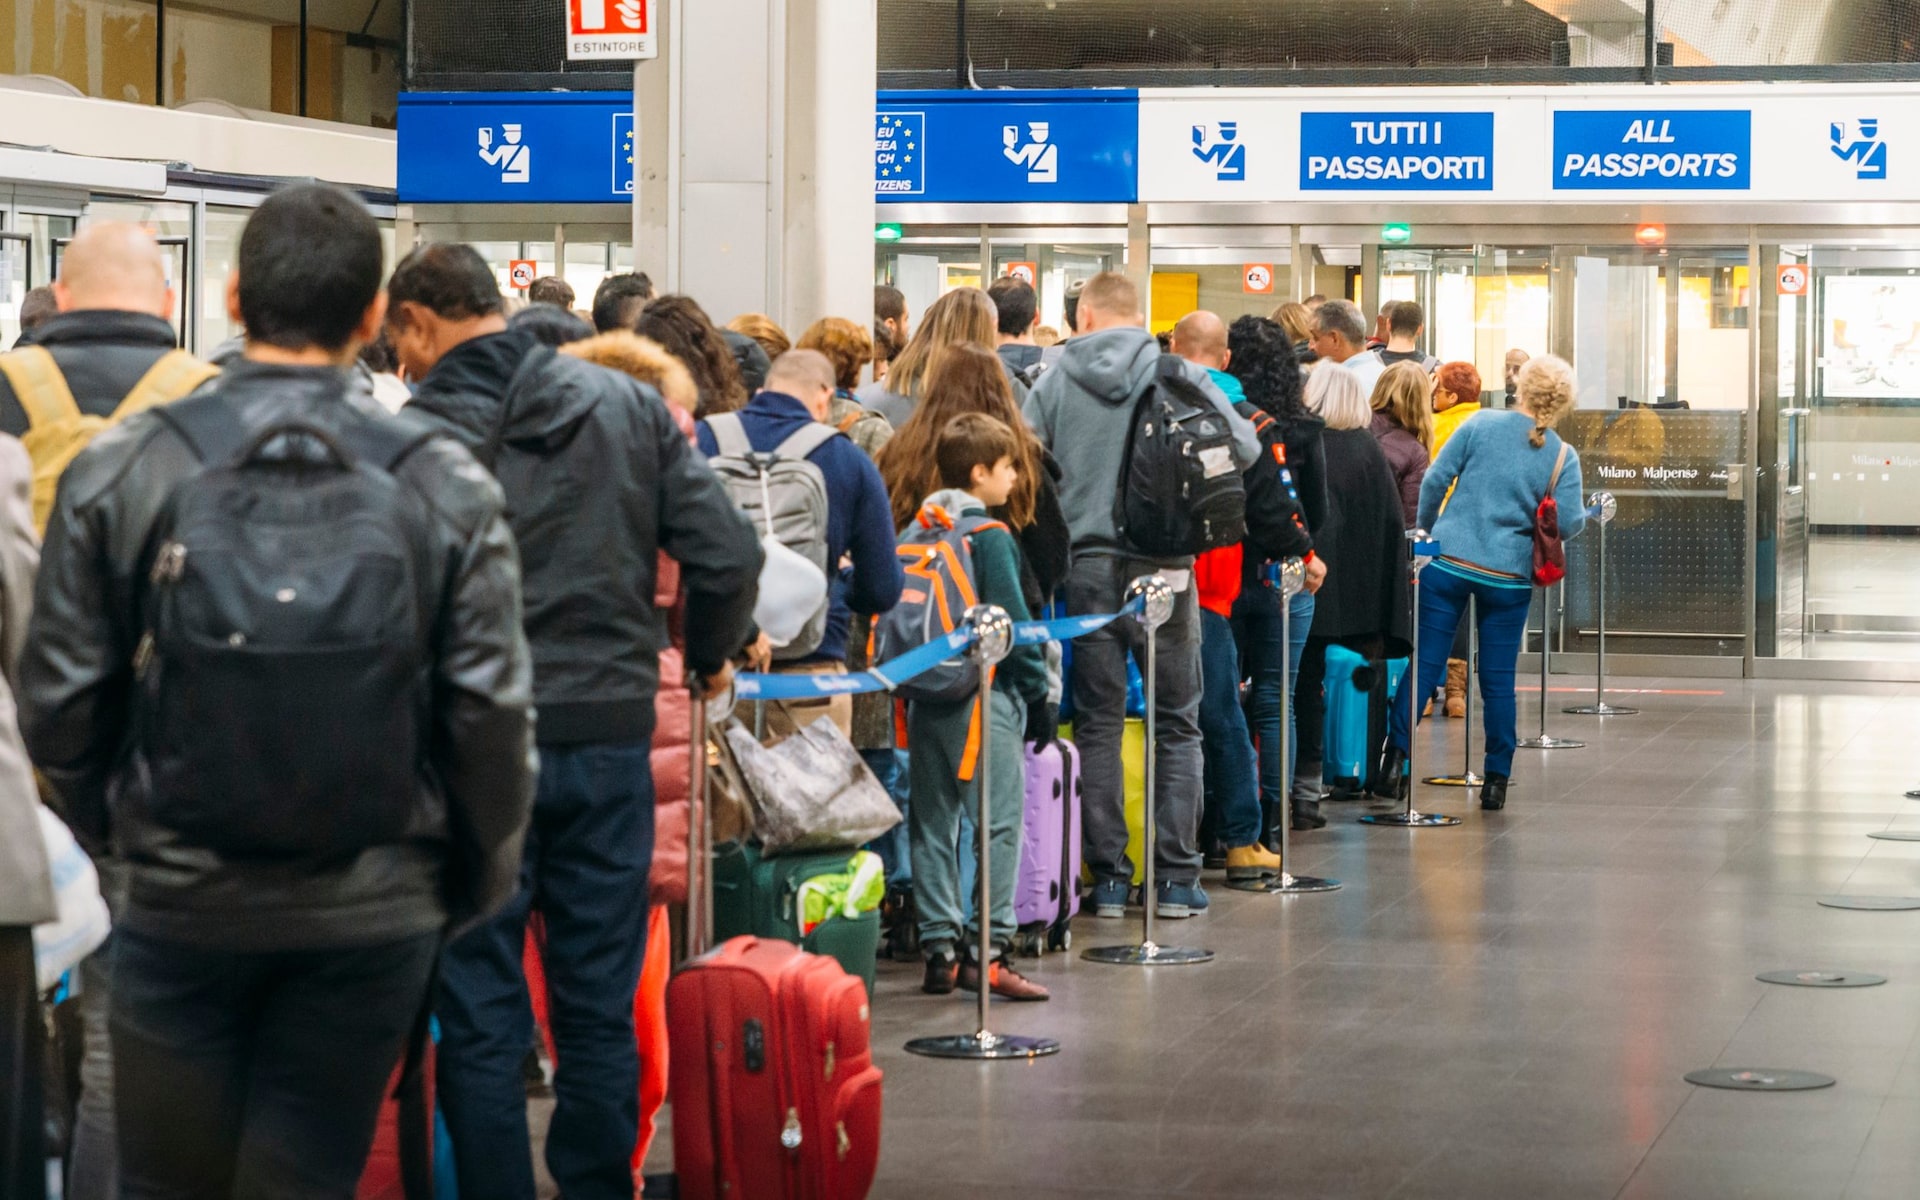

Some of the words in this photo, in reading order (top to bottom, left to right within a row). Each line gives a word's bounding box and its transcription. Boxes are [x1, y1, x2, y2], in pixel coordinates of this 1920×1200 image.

[574, 41, 646, 53] ESTINTORE
[877, 127, 895, 138] EU
[1351, 121, 1428, 145] TUTTI
[1434, 121, 1442, 145] I
[1621, 119, 1675, 143] ALL
[877, 153, 895, 164] CH
[1308, 155, 1486, 180] PASSAPORTI
[1562, 152, 1738, 178] PASSPORTS
[1598, 466, 1637, 478] Milano
[1643, 466, 1698, 481] Malpensa
